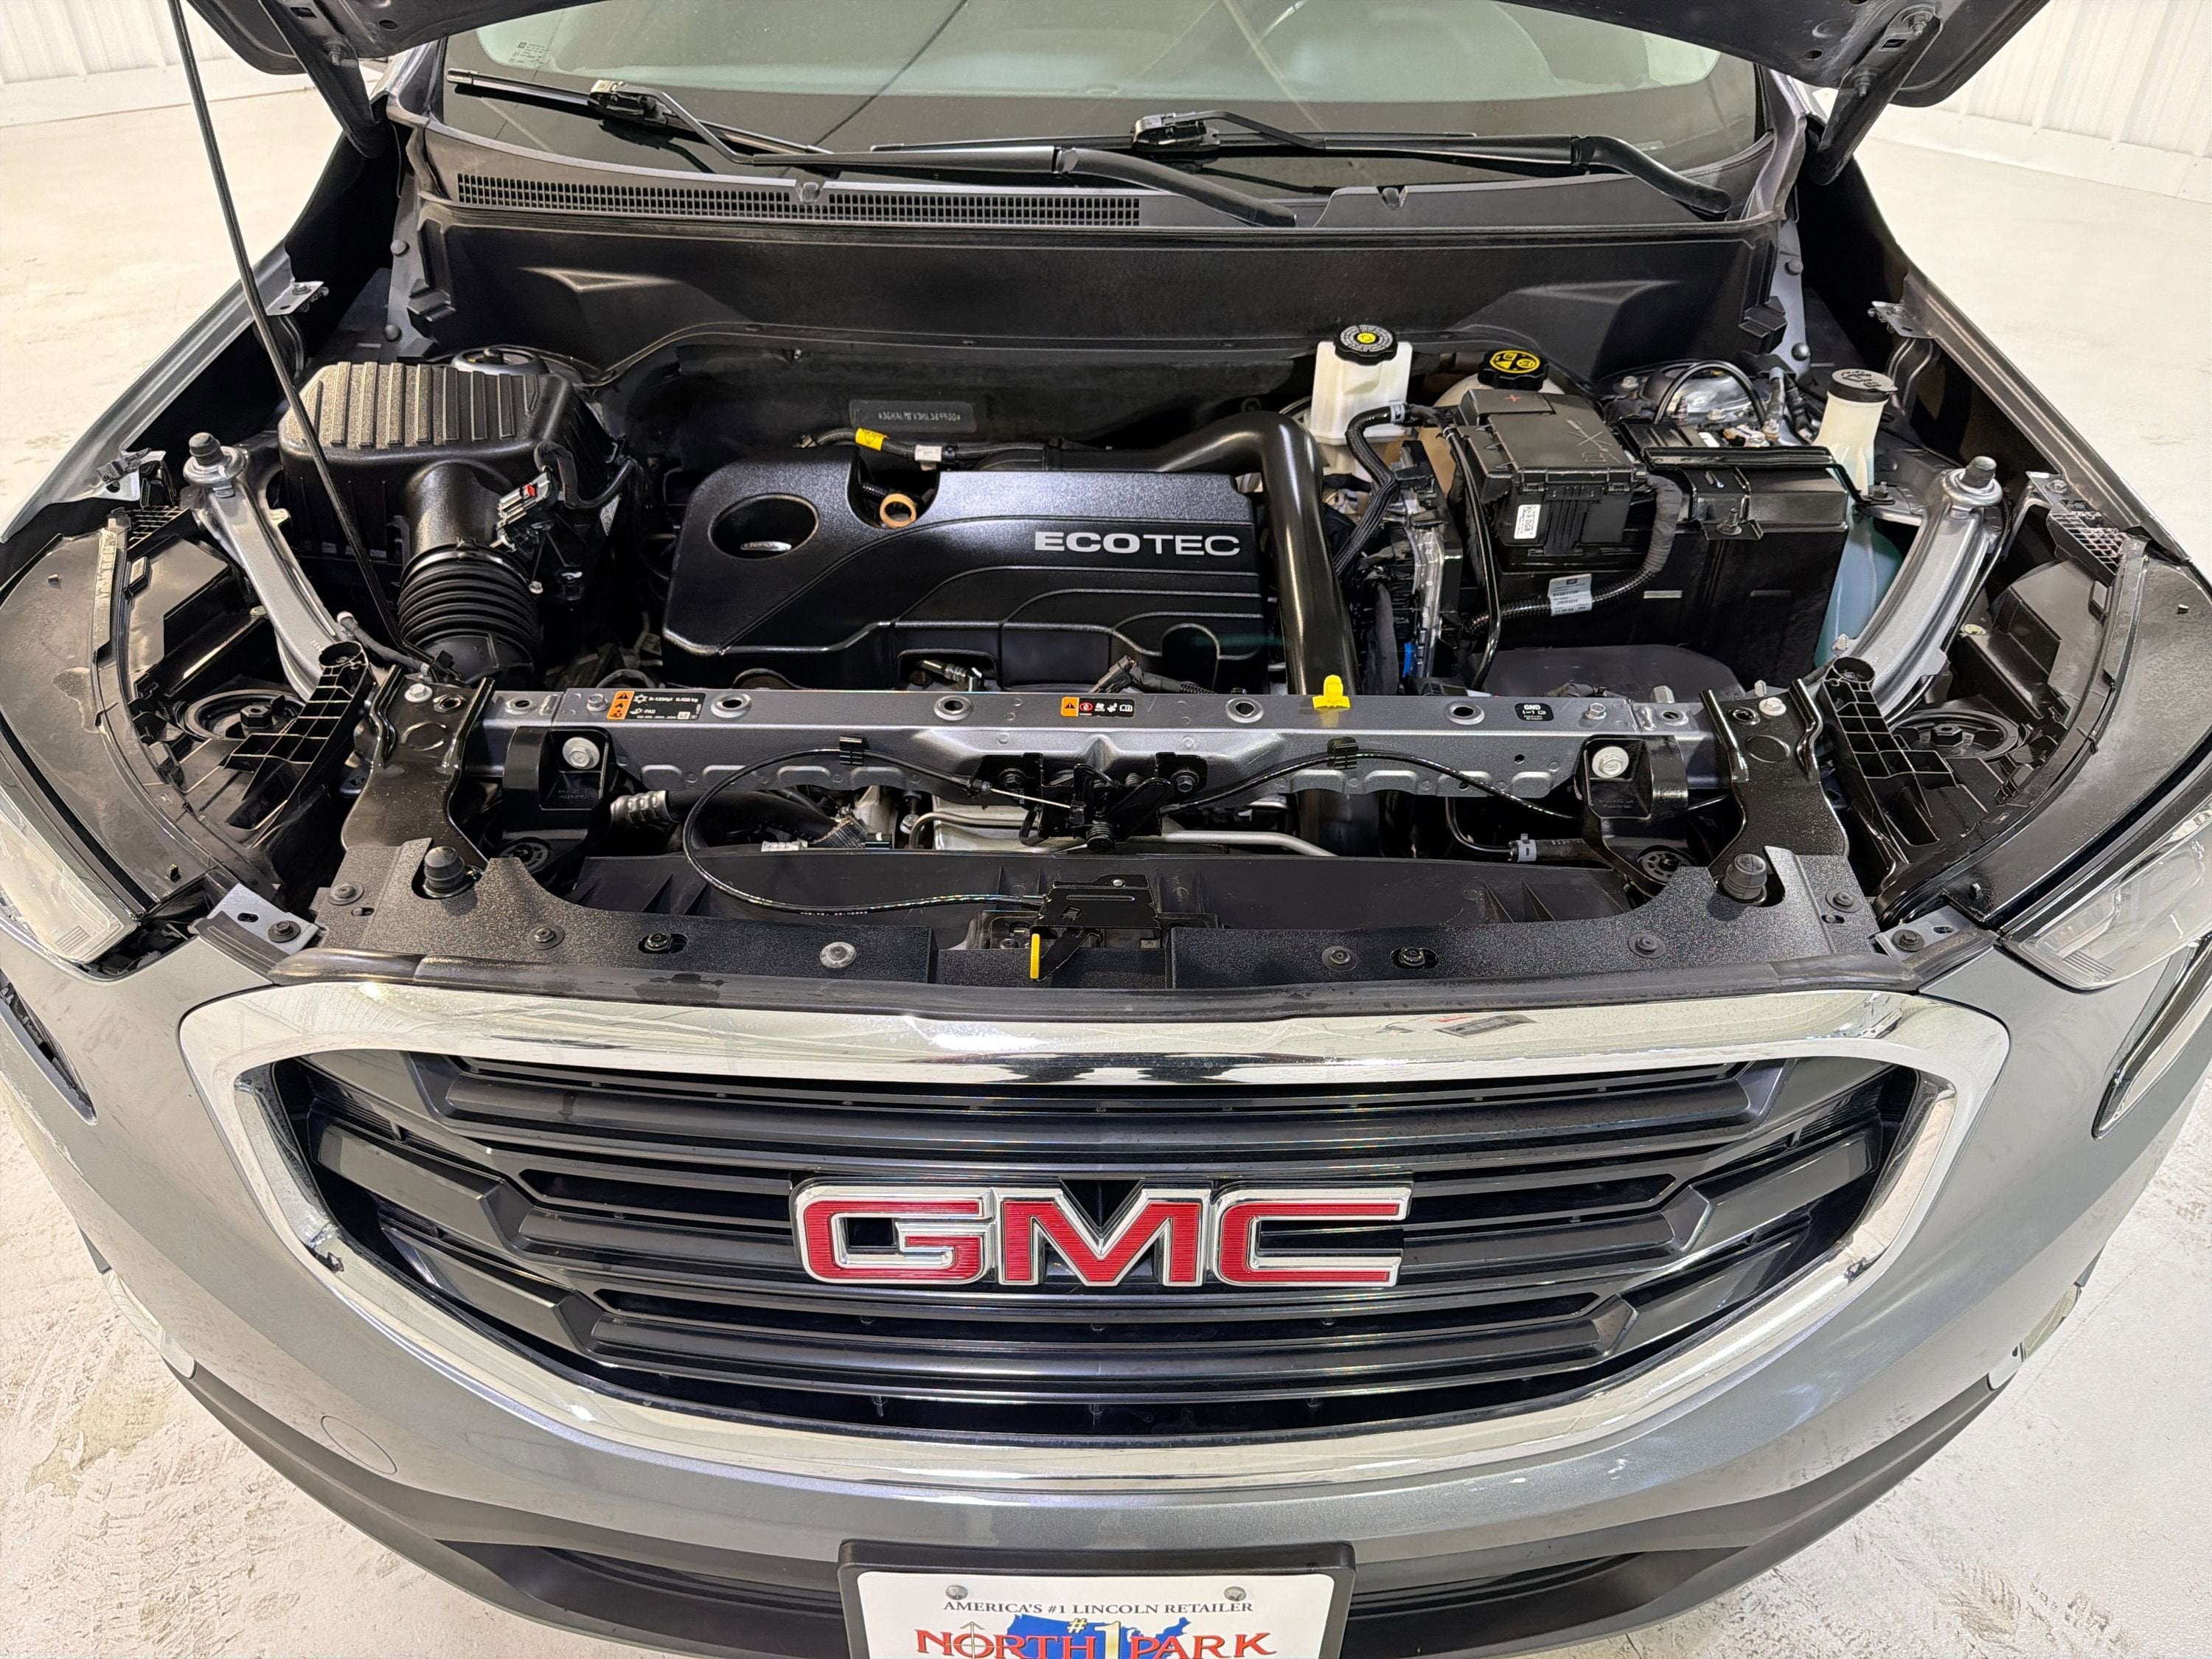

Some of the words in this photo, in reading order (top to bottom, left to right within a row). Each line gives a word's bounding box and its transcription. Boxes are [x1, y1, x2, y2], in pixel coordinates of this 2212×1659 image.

[1034, 531, 1241, 557] ECOTEC
[796, 1184, 1413, 1287] GMC
[943, 1601, 1043, 1614] AMERICA'S
[1048, 1604, 1067, 1614] #1
[1073, 1603, 1159, 1614] LINCOLN
[1164, 1601, 1254, 1614] RETAILER
[914, 1629, 1099, 1659] NORTH
[1129, 1632, 1279, 1659] PARK
